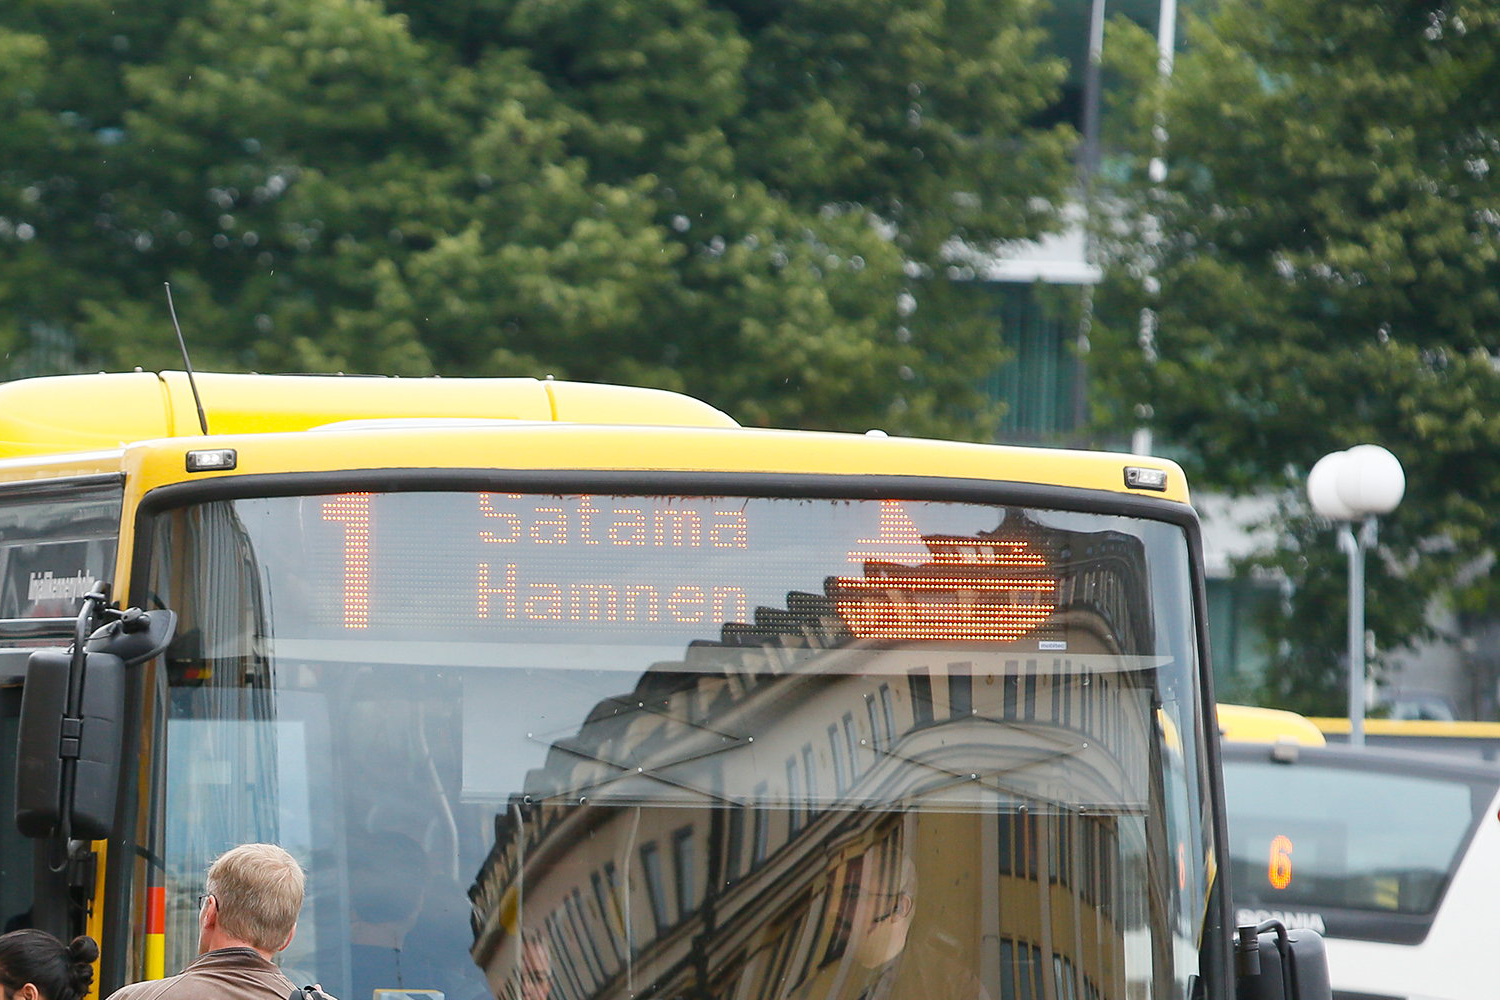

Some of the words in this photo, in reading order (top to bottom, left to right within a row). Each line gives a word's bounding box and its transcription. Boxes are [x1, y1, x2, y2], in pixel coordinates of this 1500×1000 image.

[322, 491, 370, 629] 1
[478, 493, 749, 549] Satama
[477, 562, 747, 624] Hamnen
[1268, 835, 1293, 890] 6
